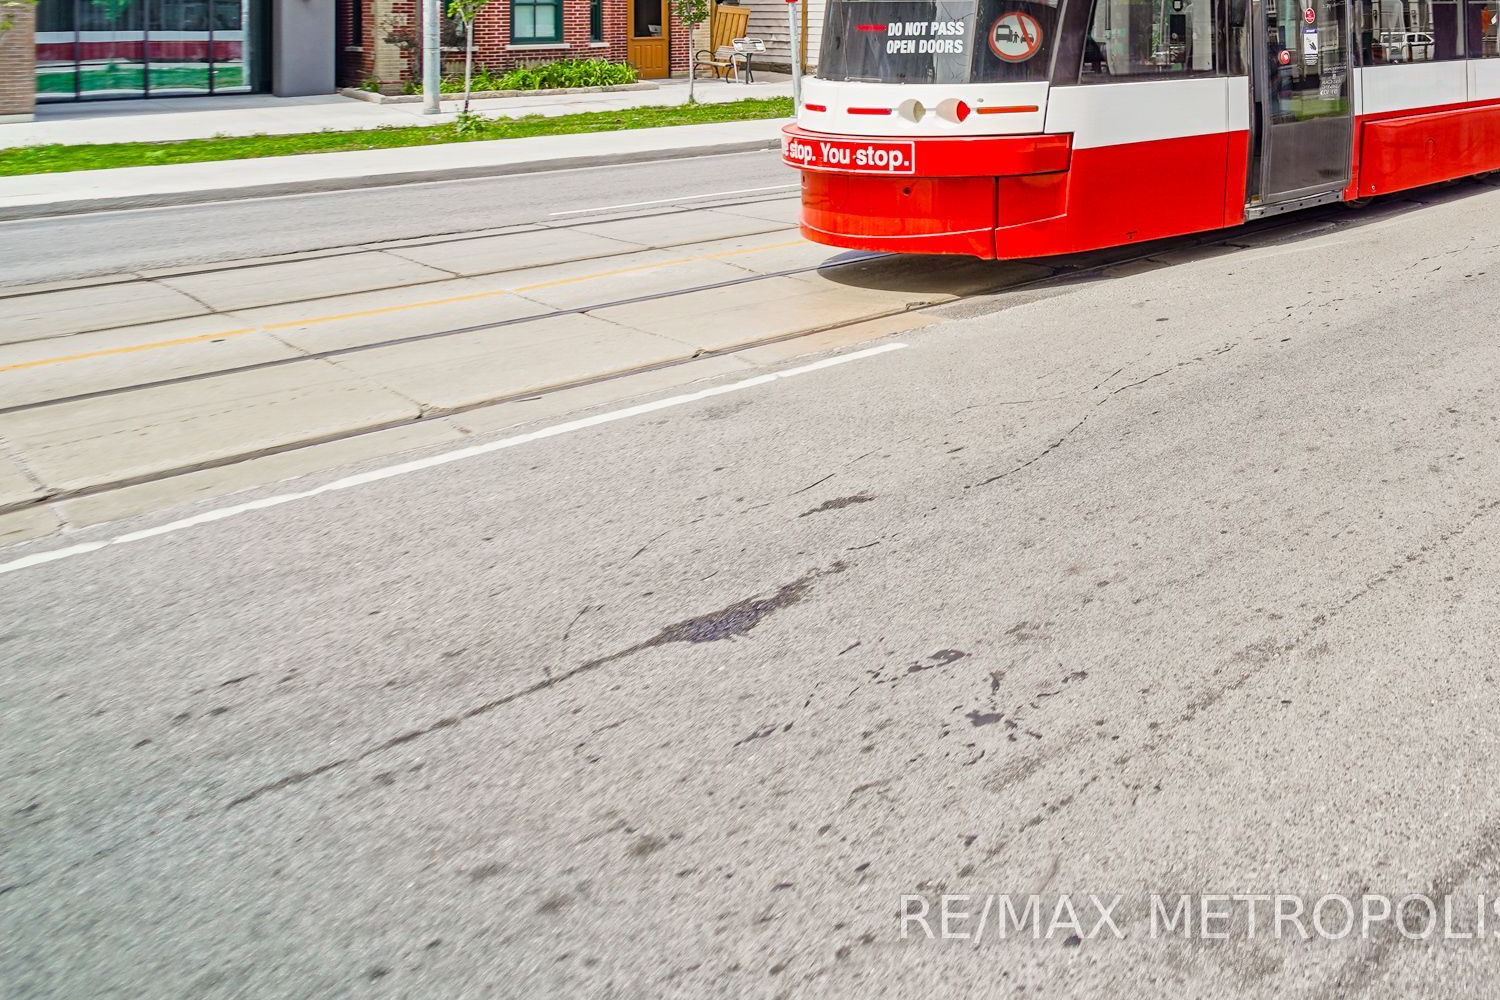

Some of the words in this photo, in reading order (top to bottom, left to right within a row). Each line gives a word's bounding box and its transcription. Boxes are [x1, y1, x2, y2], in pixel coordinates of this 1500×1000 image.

[888, 22, 902, 36] DO
[905, 22, 928, 36] NOT
[930, 21, 965, 36] PASS
[886, 40, 916, 54] OPEN
[918, 39, 964, 54] DOORS
[789, 140, 816, 165] stop.
[820, 142, 850, 164] You
[856, 146, 910, 171] stop.
